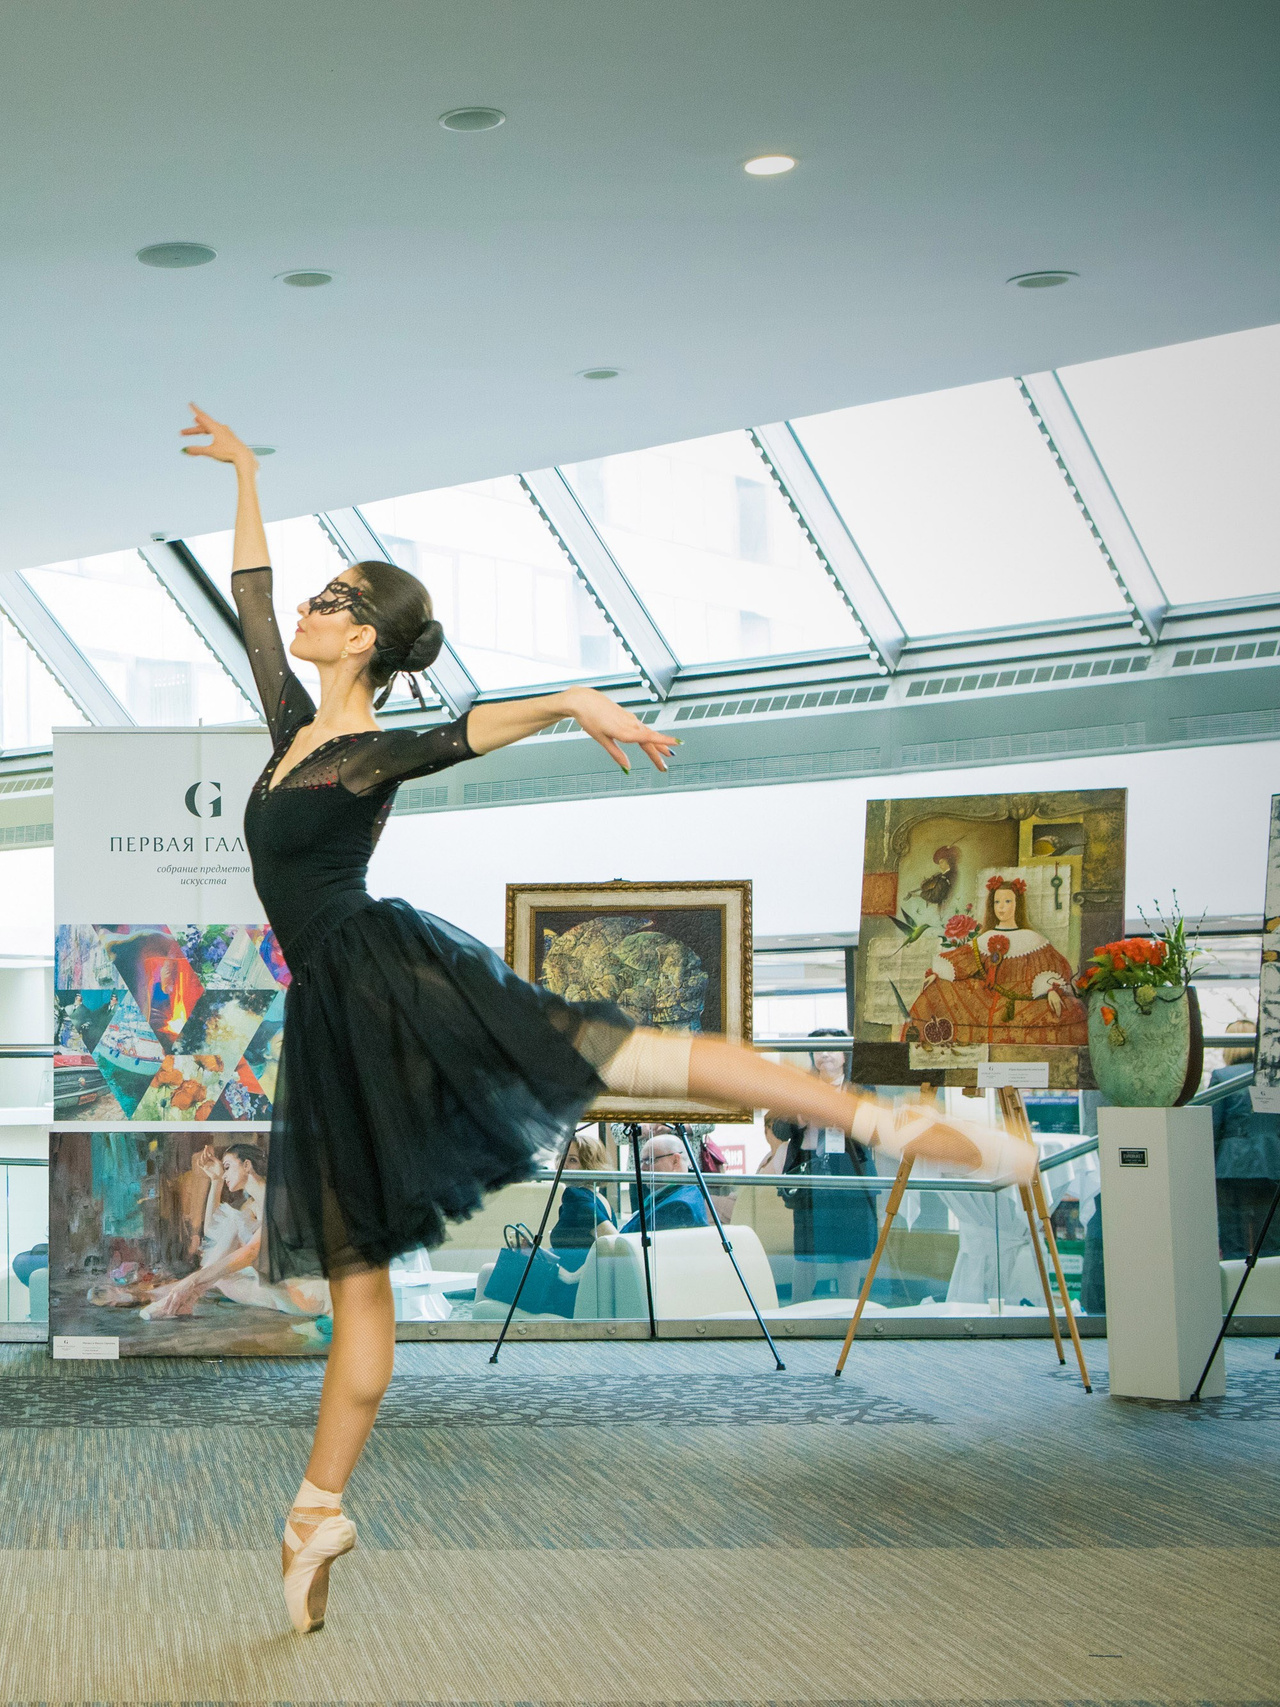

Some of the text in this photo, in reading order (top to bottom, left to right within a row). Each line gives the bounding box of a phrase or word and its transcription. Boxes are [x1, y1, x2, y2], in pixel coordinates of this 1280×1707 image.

[185, 781, 222, 818] G
[110, 836, 194, 852] ПЕРВАЯ
[156, 864, 251, 876] собрание предметов
[180, 876, 227, 887] искусства
